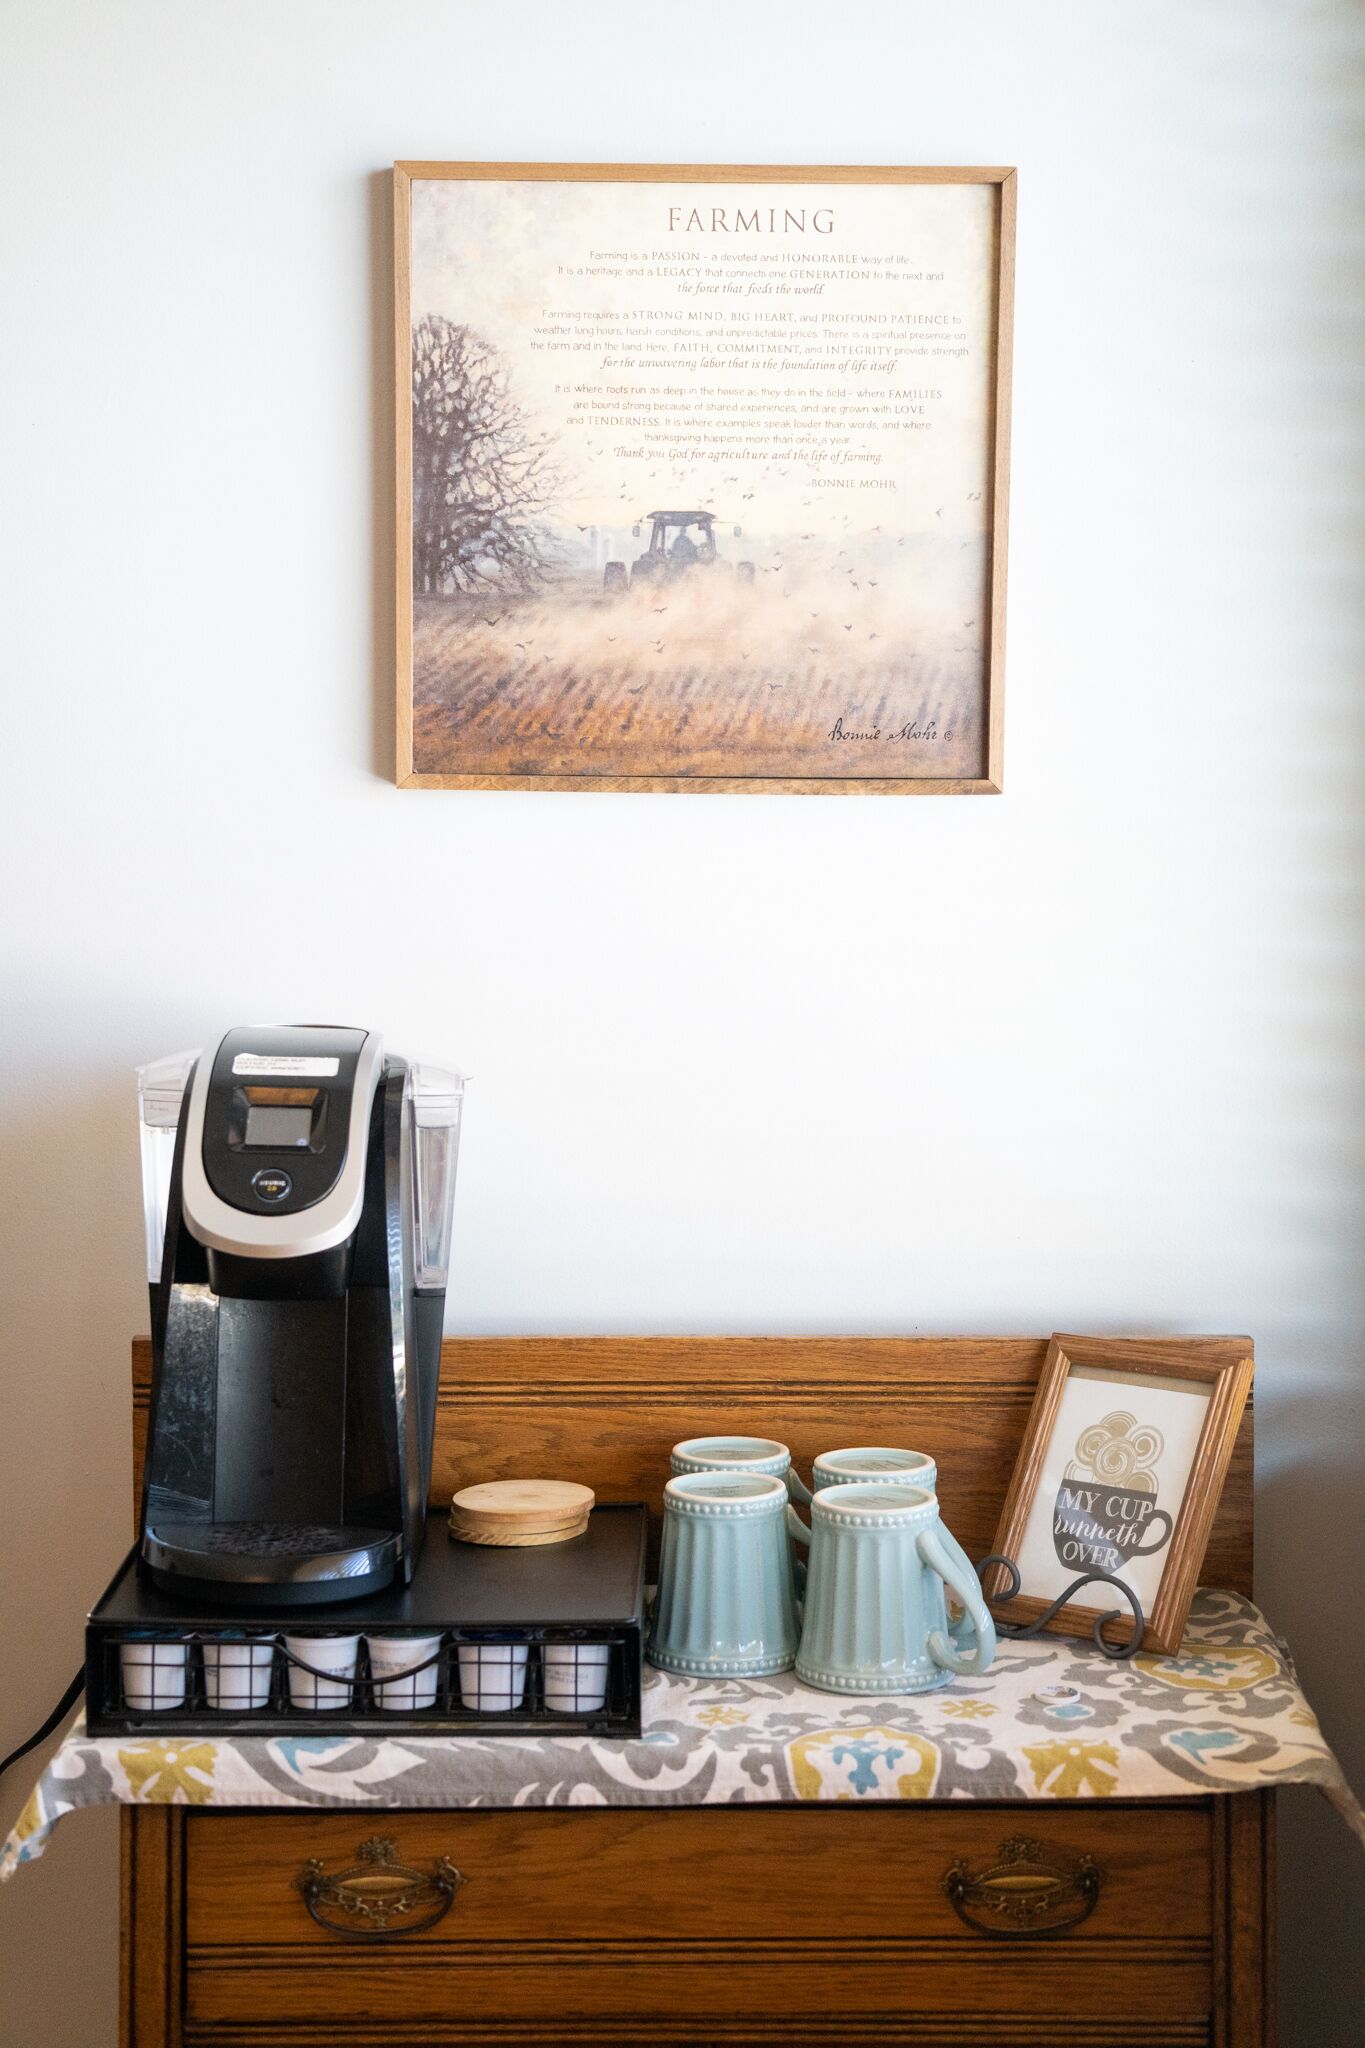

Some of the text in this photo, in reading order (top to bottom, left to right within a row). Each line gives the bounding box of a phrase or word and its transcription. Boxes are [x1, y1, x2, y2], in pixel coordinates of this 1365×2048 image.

[668, 207, 834, 233] FARMING
[590, 250, 628, 263] Farming
[630, 251, 639, 260] is
[652, 251, 700, 261] PASSION
[720, 252, 758, 262] devoted
[760, 253, 779, 262] and
[782, 253, 858, 264] HONORABLE
[861, 257, 882, 267] way
[885, 255, 896, 264] of
[558, 266, 564, 275] It
[566, 266, 574, 275] is
[586, 266, 623, 279] heritage
[626, 266, 644, 276] and
[656, 267, 702, 277] LEGACY
[704, 268, 723, 277] that
[725, 268, 766, 278] connects
[789, 269, 870, 280] GENERATION
[873, 270, 883, 280] to
[885, 271, 900, 280] the
[902, 271, 923, 280] next
[926, 271, 944, 281] and
[678, 282, 692, 293] the
[693, 283, 720, 297] force
[722, 283, 743, 294] that
[745, 283, 773, 298] feeds
[776, 284, 791, 294] the
[542, 310, 580, 323] Farming
[583, 310, 620, 323] requires
[632, 311, 684, 321] STRONG
[730, 312, 750, 322] BIG
[754, 312, 797, 324] HEART,
[800, 313, 818, 323] and
[822, 313, 887, 324] PROFOUND
[890, 314, 950, 324] PATIENCE
[952, 315, 962, 325] to
[534, 325, 571, 335] weather
[626, 326, 652, 336] harsh
[705, 327, 724, 337] and
[726, 328, 787, 341] unpredictable
[822, 329, 849, 339] There
[852, 330, 861, 339] is
[872, 330, 908, 343] spiritual
[909, 332, 951, 343] presence
[530, 340, 545, 350] the
[547, 341, 570, 350] farm
[572, 341, 591, 351] and
[593, 342, 602, 351] in
[604, 342, 619, 351] the
[804, 344, 823, 354] and
[826, 345, 893, 355] INTEGRITY
[894, 346, 929, 359] provide
[932, 346, 969, 359] strength
[600, 356, 897, 374] for the unwavering labor that is the foundation of life itself.
[554, 384, 561, 393] It
[563, 384, 571, 393] is
[574, 384, 603, 394] where
[606, 385, 629, 394] roots
[663, 386, 686, 398] deep
[688, 386, 698, 395] in
[700, 386, 715, 396] the
[717, 386, 745, 396] house
[761, 387, 781, 400] they
[784, 388, 796, 397] do
[798, 388, 806, 397] in
[809, 388, 824, 397] the
[826, 388, 846, 398] field
[856, 389, 885, 398] where
[888, 389, 943, 399] FAMILIES
[591, 400, 620, 409] bound
[622, 400, 651, 413] strong
[653, 401, 692, 411] because
[694, 402, 704, 411] of
[706, 402, 738, 411] shared
[801, 403, 819, 413] and
[839, 406, 869, 416] grown
[872, 404, 892, 414] with
[894, 405, 925, 414] LOVE
[566, 416, 584, 425] and
[665, 417, 672, 426] It
[674, 417, 681, 426] is
[684, 417, 713, 426] where
[715, 418, 761, 430] examples
[763, 418, 791, 431] speak
[794, 418, 822, 428] louder
[824, 419, 846, 428] than
[848, 419, 879, 431] words,
[882, 420, 900, 429] and
[902, 420, 932, 430] where
[644, 432, 701, 445] thanksgiving
[704, 433, 743, 446] happens
[773, 434, 794, 443] than
[613, 447, 884, 465] Thank you God for agriculture and the life of farming.
[859, 479, 897, 489] MOHR
[828, 718, 937, 742] Bonnie Mohr
[1058, 1488, 1153, 1522] MY CUP
[1054, 1514, 1142, 1547] runneth
[1062, 1541, 1118, 1569] OVER
